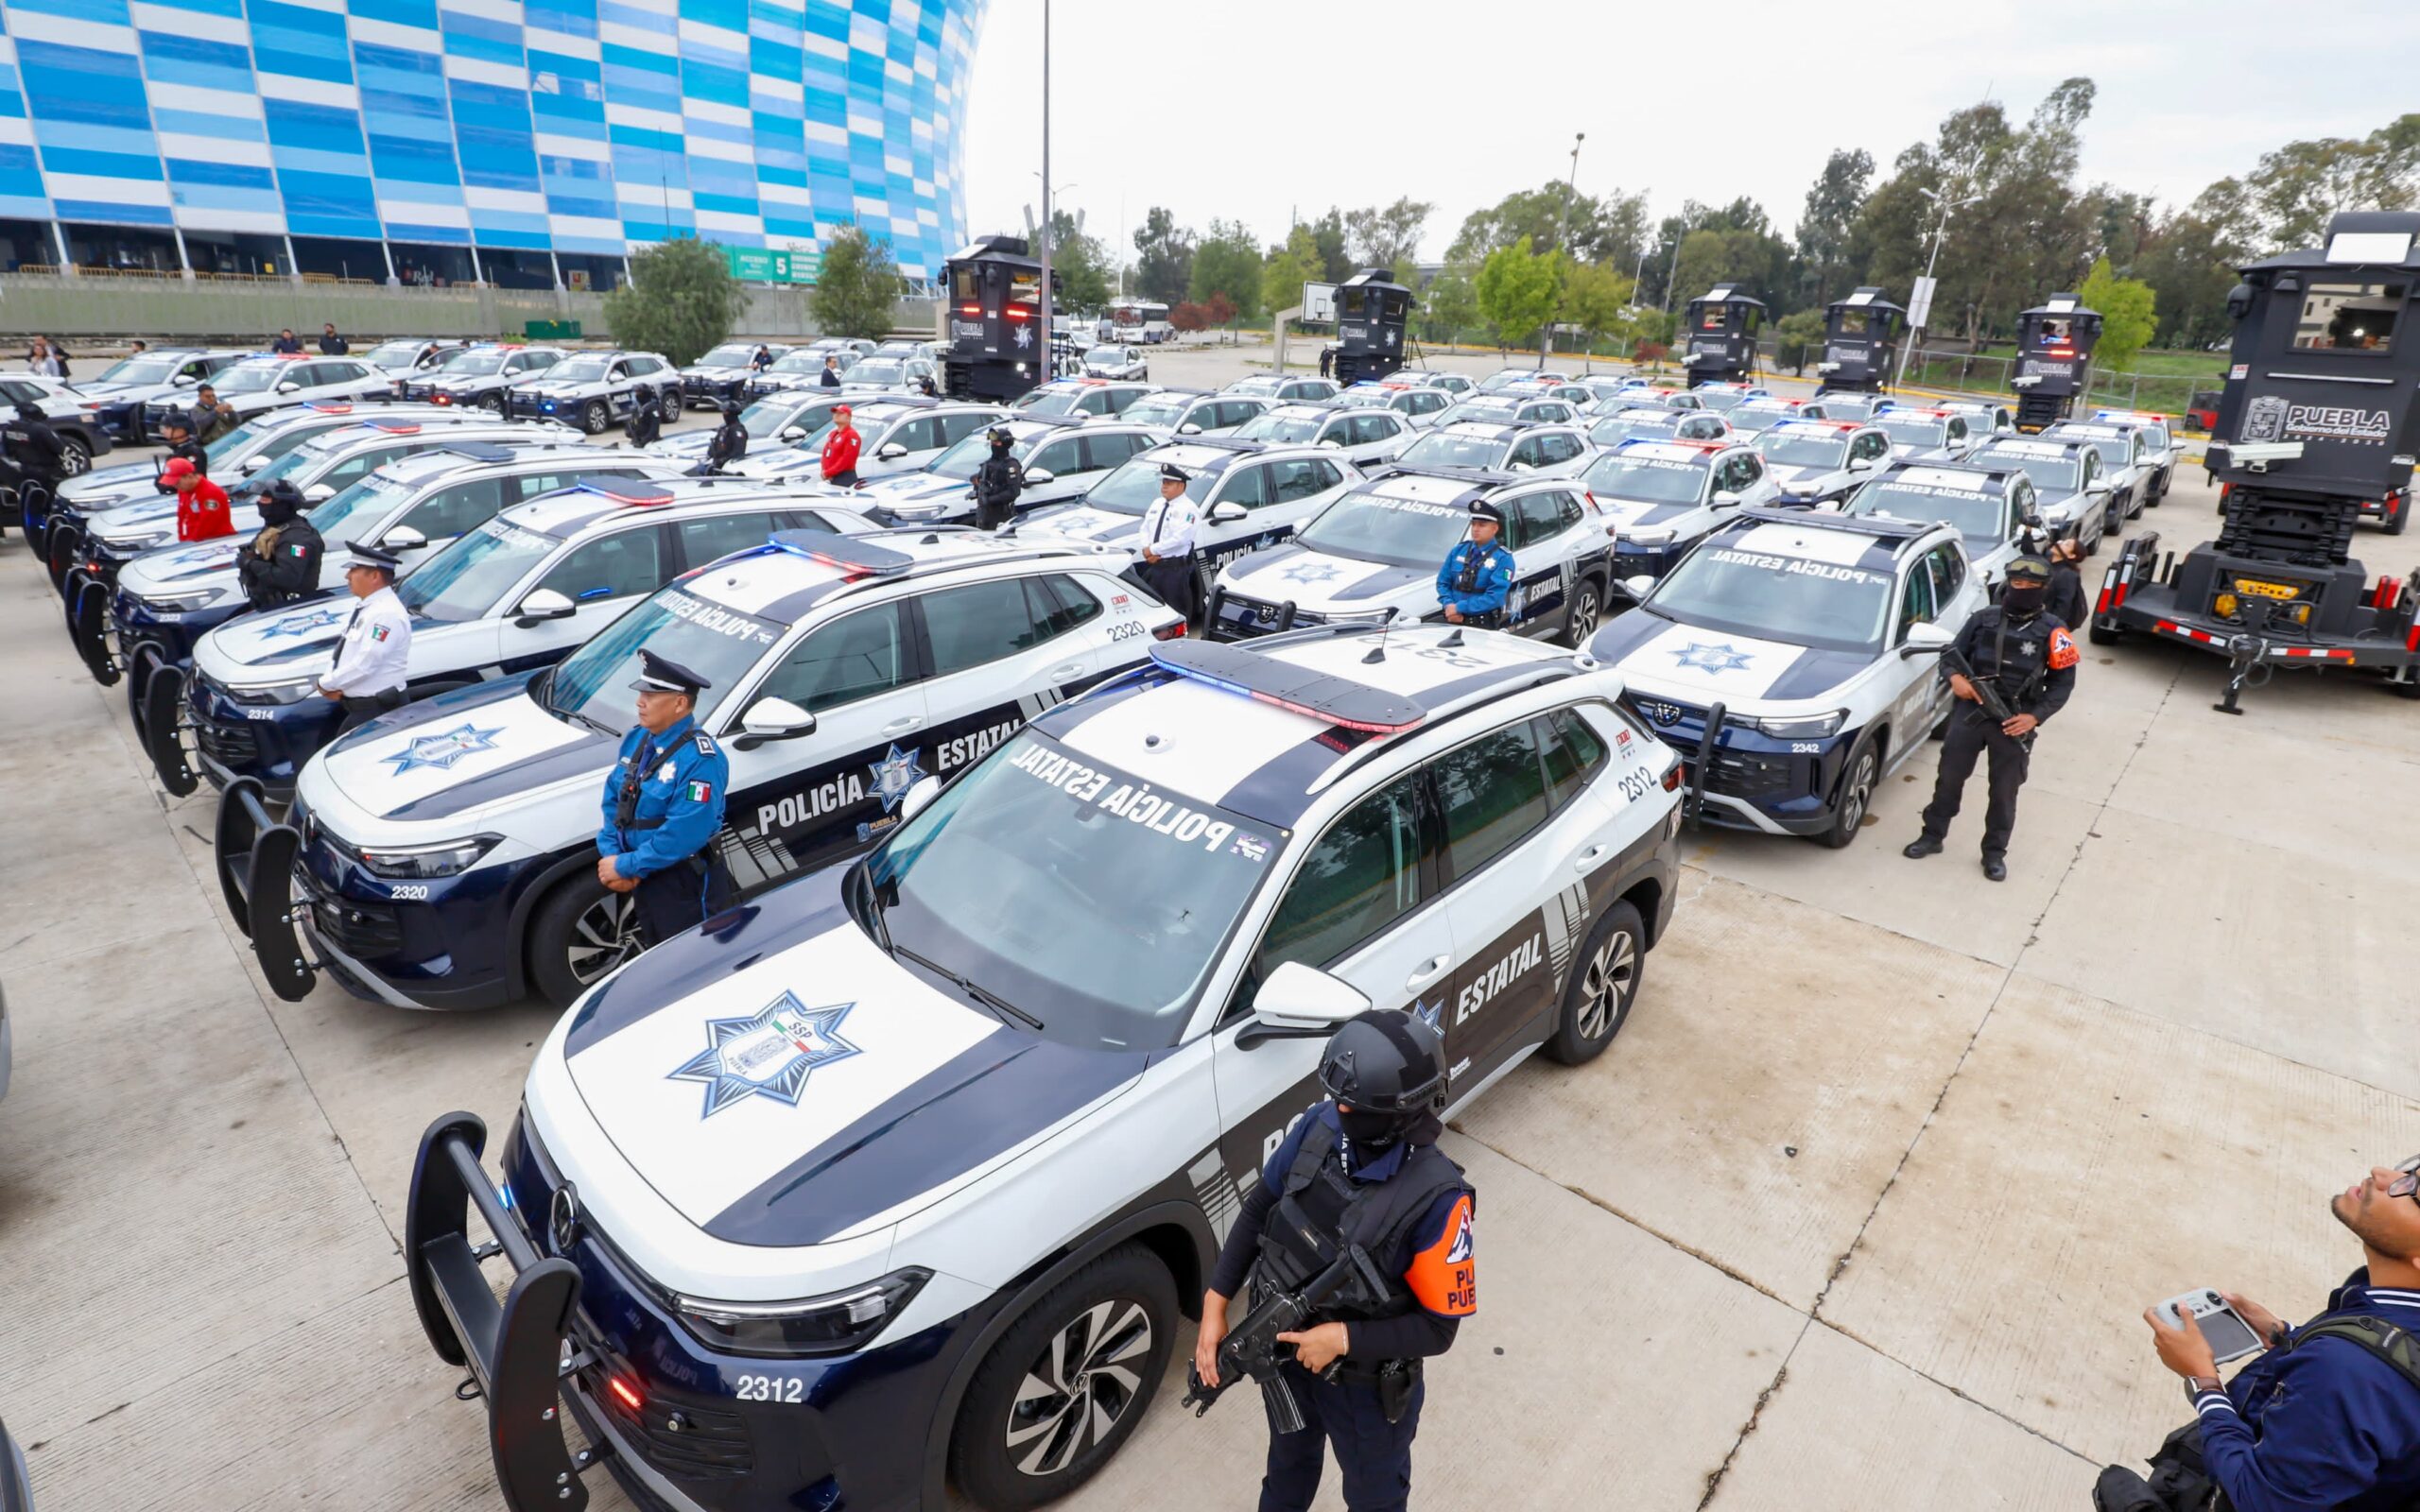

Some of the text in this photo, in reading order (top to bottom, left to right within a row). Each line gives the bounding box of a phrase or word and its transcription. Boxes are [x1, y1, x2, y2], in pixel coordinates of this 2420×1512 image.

[776, 257, 787, 275] 5
[2286, 404, 2391, 430] PUEBLA
[2285, 423, 2388, 438] Gobierno del Estado
[1530, 574, 1562, 602] ESTATAL
[1106, 620, 1146, 643] 2320
[248, 709, 274, 720] 2314
[1791, 743, 1820, 754] 2342
[1617, 765, 1658, 803] 2312
[757, 772, 864, 836] POLICÍA
[390, 885, 428, 900] 2320
[1456, 932, 1543, 1026] ESTATAL
[788, 1022, 813, 1039] SSP
[1447, 1286, 1476, 1310] PUE
[736, 1375, 804, 1403] 2312
